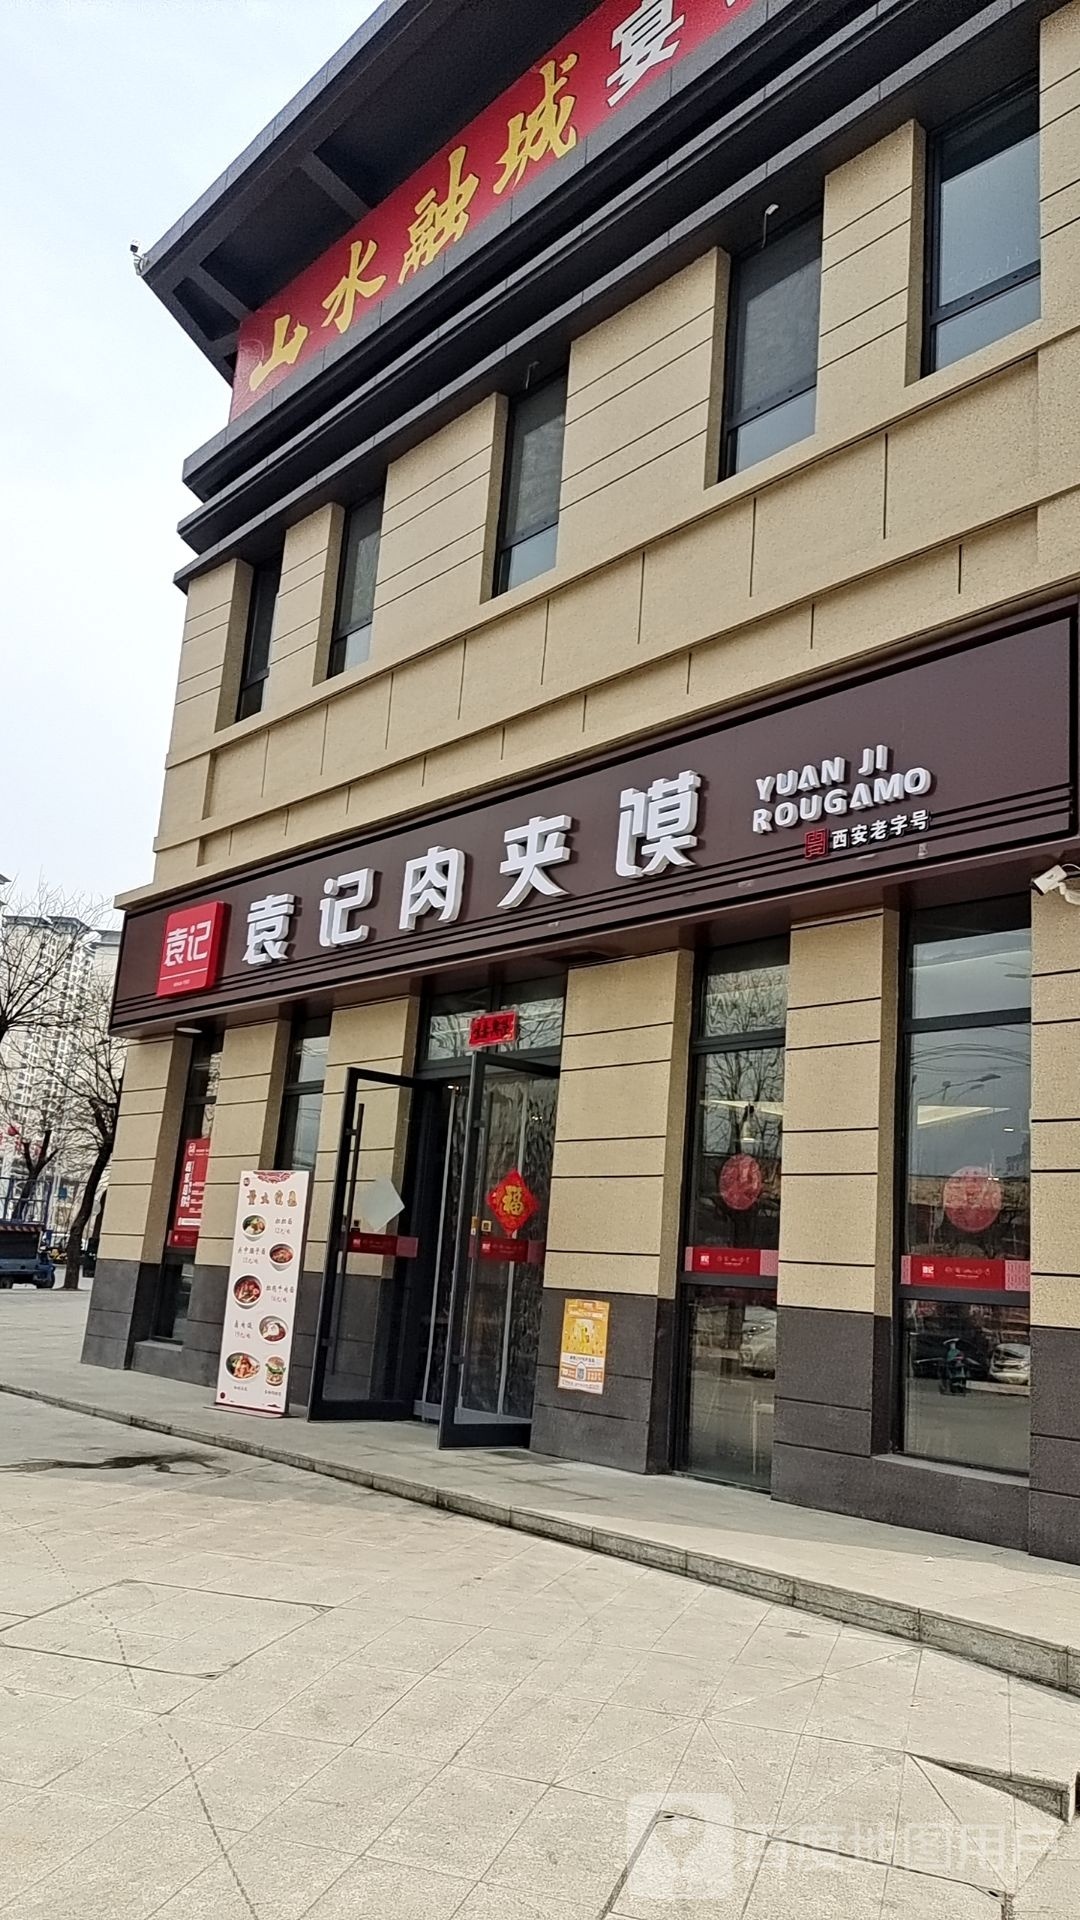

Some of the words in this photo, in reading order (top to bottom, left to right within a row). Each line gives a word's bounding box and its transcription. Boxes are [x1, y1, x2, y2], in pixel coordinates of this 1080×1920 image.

[755, 756, 846, 802] YUAN
[858, 744, 889, 776] JI
[752, 767, 932, 834] ROUGAMO
[831, 809, 931, 849] 西安老字号
[242, 769, 703, 966] 袁记肉夹馍
[163, 919, 212, 967] 袁记
[502, 1184, 524, 1215] 福
